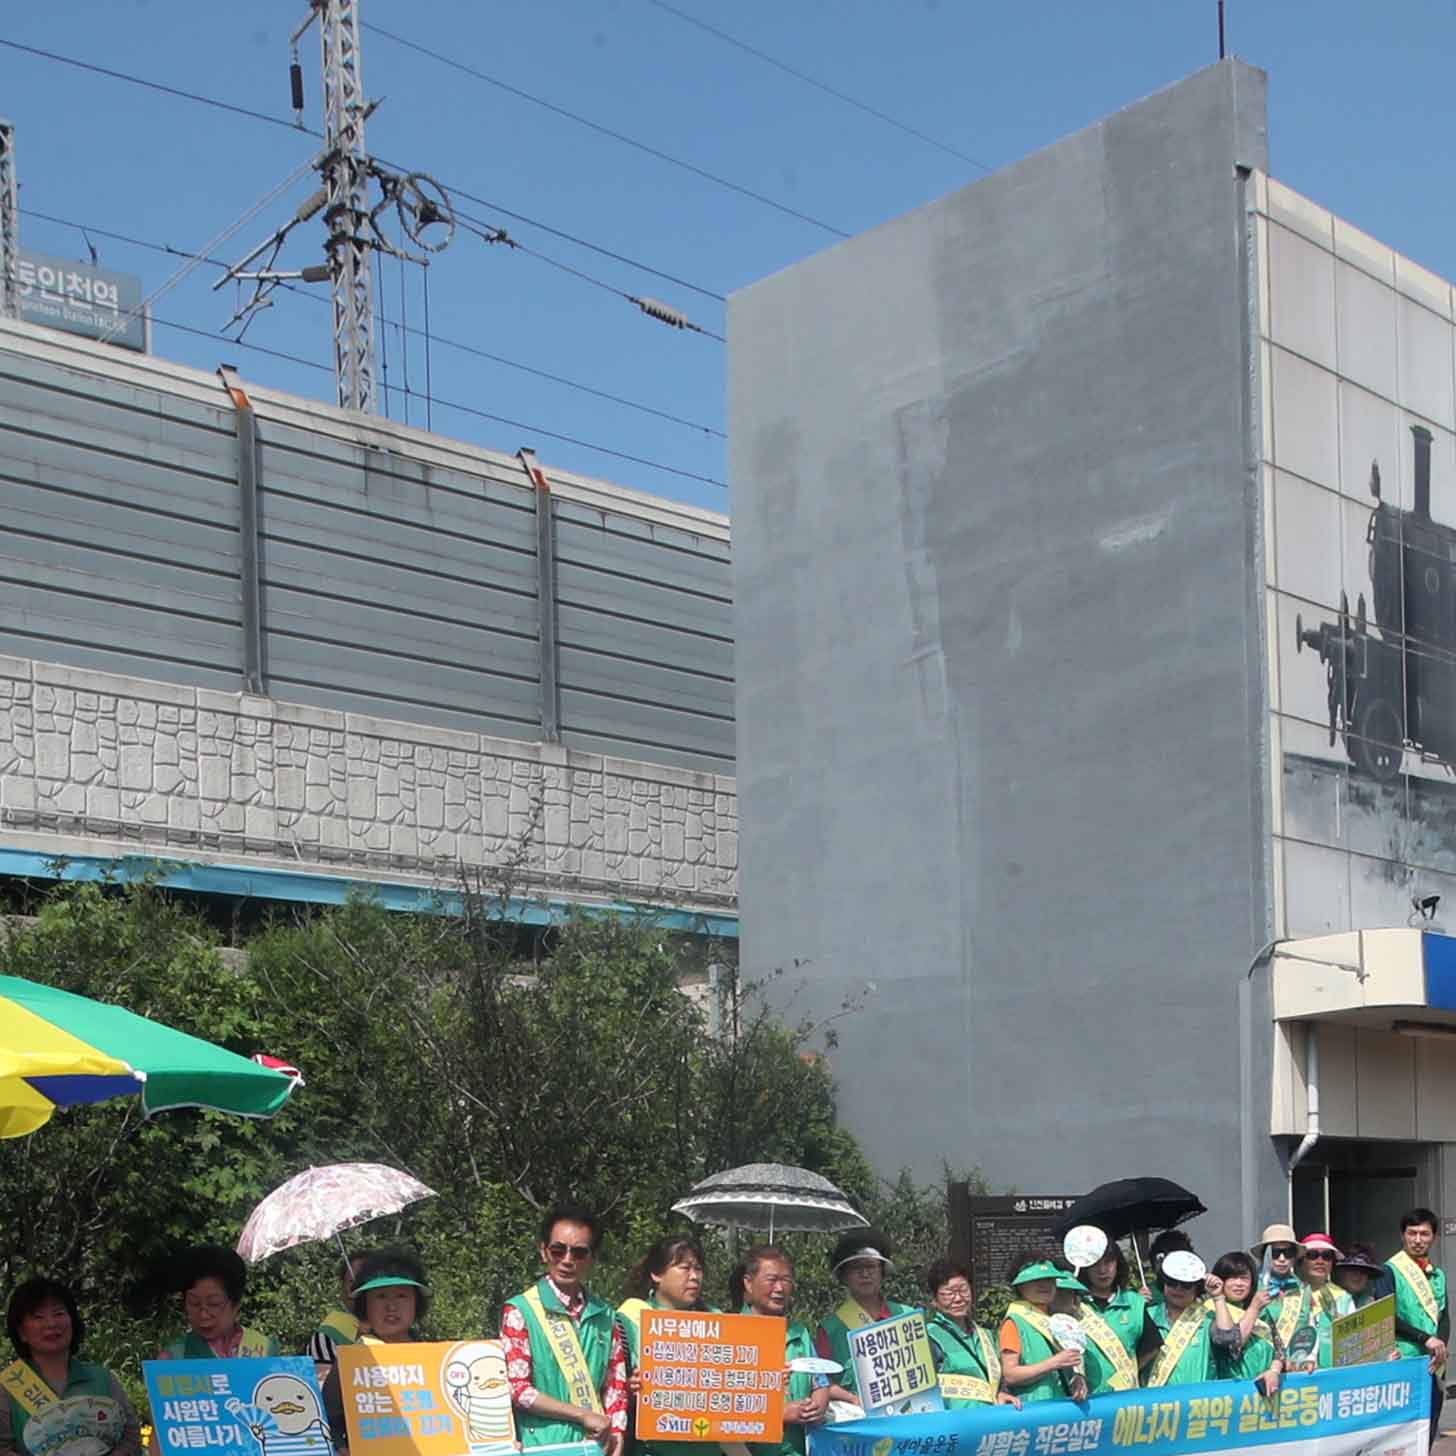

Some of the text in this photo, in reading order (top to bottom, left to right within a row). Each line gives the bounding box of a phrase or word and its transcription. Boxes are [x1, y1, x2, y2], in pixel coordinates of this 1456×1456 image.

[649, 1318, 720, 1339] 사무실에서
[855, 1320, 925, 1358] 사용하지 않는
[653, 1341, 758, 1366] 점심시간 조명등 끄기
[872, 1344, 917, 1377] 전자기기
[352, 1364, 425, 1388] 사용하지
[652, 1367, 697, 1387] 사용하지
[700, 1368, 722, 1389] 않는
[759, 1370, 782, 1391] 끄기
[869, 1375, 903, 1404] 플러그
[906, 1363, 929, 1391] 뽑기
[163, 1399, 219, 1422] 시원한
[355, 1391, 393, 1414] 않는
[1112, 1400, 1181, 1447] 에너지
[1186, 1396, 1232, 1440] 절약
[1337, 1381, 1411, 1419] 동참합시다!
[168, 1423, 243, 1449] 여름나기
[896, 1434, 959, 1456] 새마을운동
